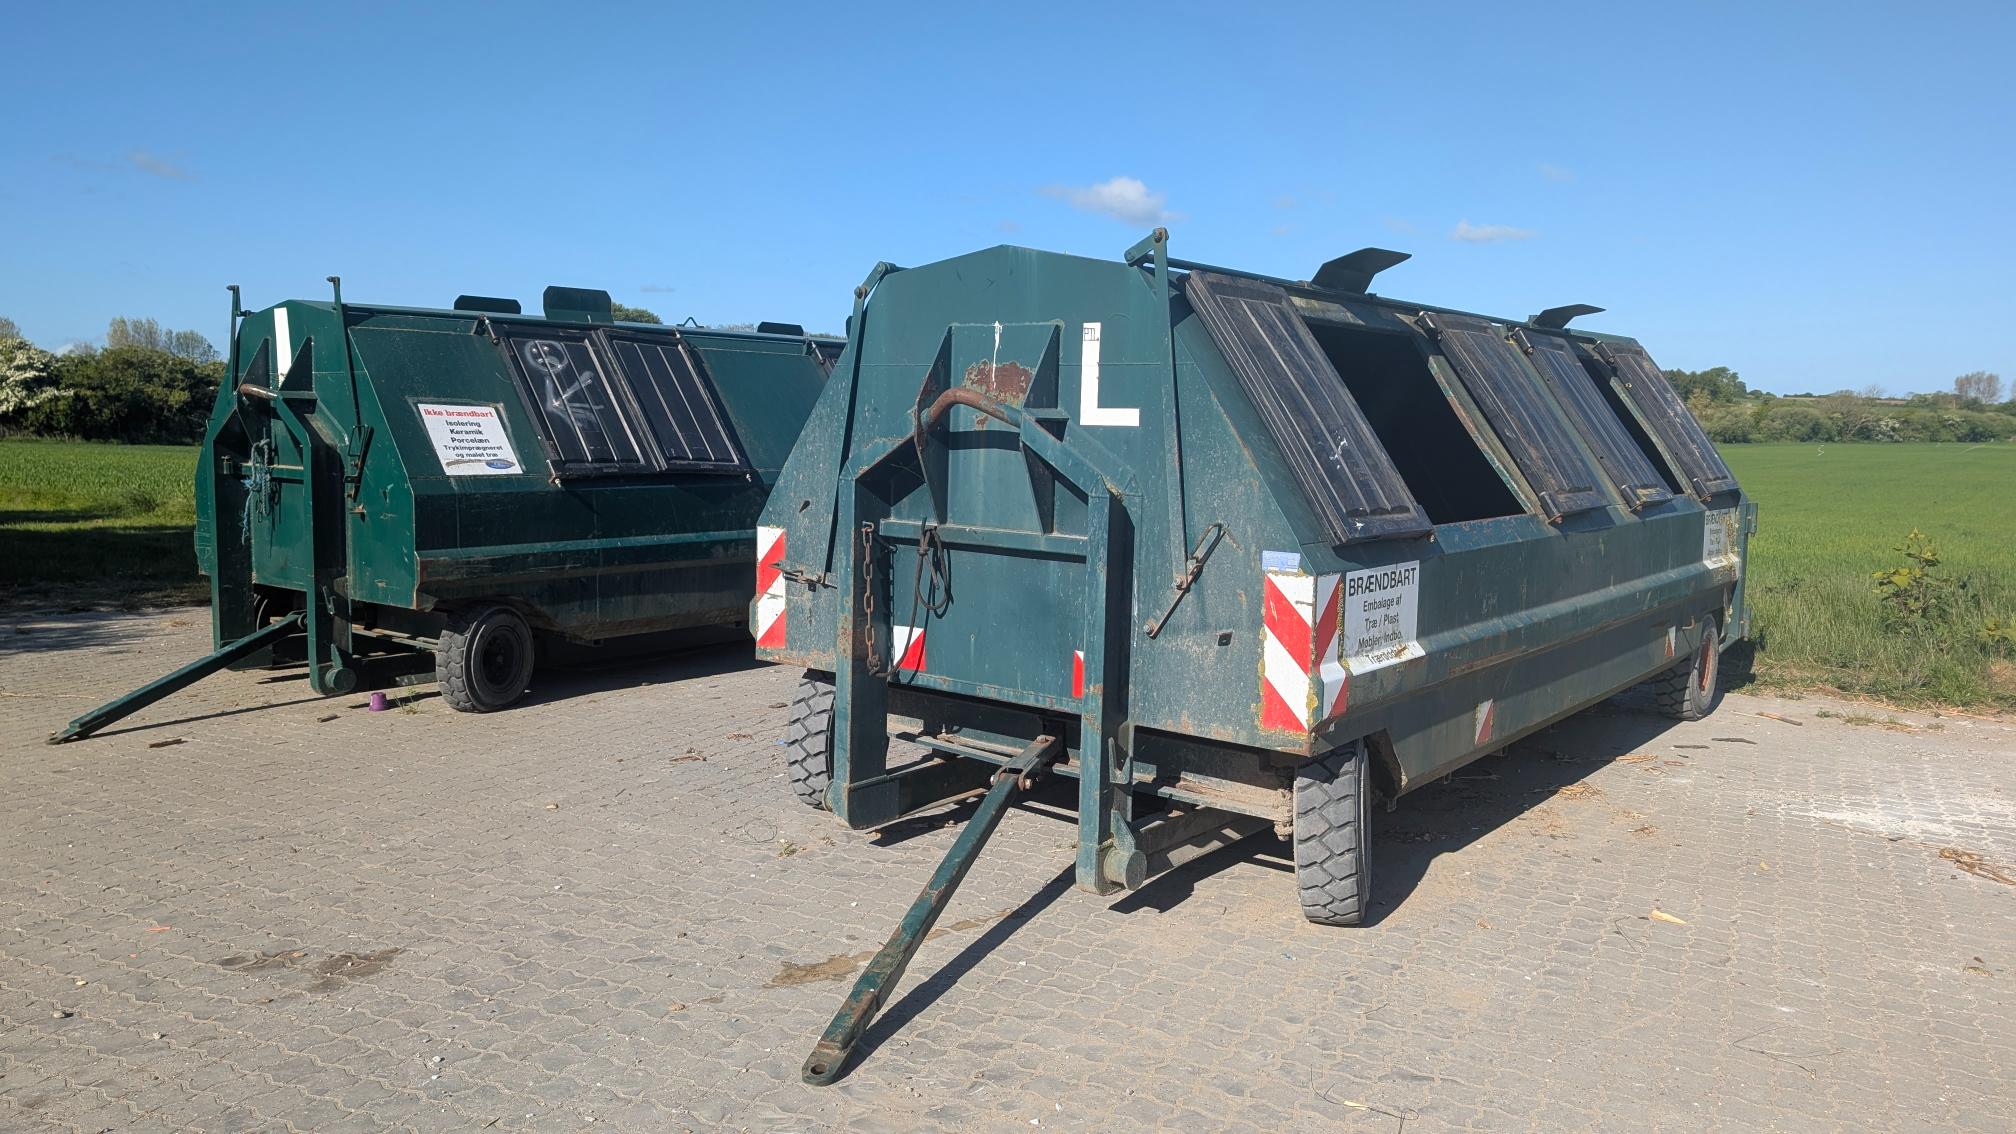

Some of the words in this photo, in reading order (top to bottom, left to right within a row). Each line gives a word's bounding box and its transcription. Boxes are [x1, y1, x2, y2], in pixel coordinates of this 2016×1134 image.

[1080, 322, 1140, 427] L
[423, 409, 444, 417] Ikke
[445, 409, 494, 418] brændbart
[446, 420, 481, 428] Isolering
[1348, 567, 1416, 597] BRÆNDBART
[1363, 597, 1395, 612] Embalage
[1395, 594, 1402, 605] af
[1365, 618, 1378, 631] Træ
[1383, 612, 1399, 626] Plast
